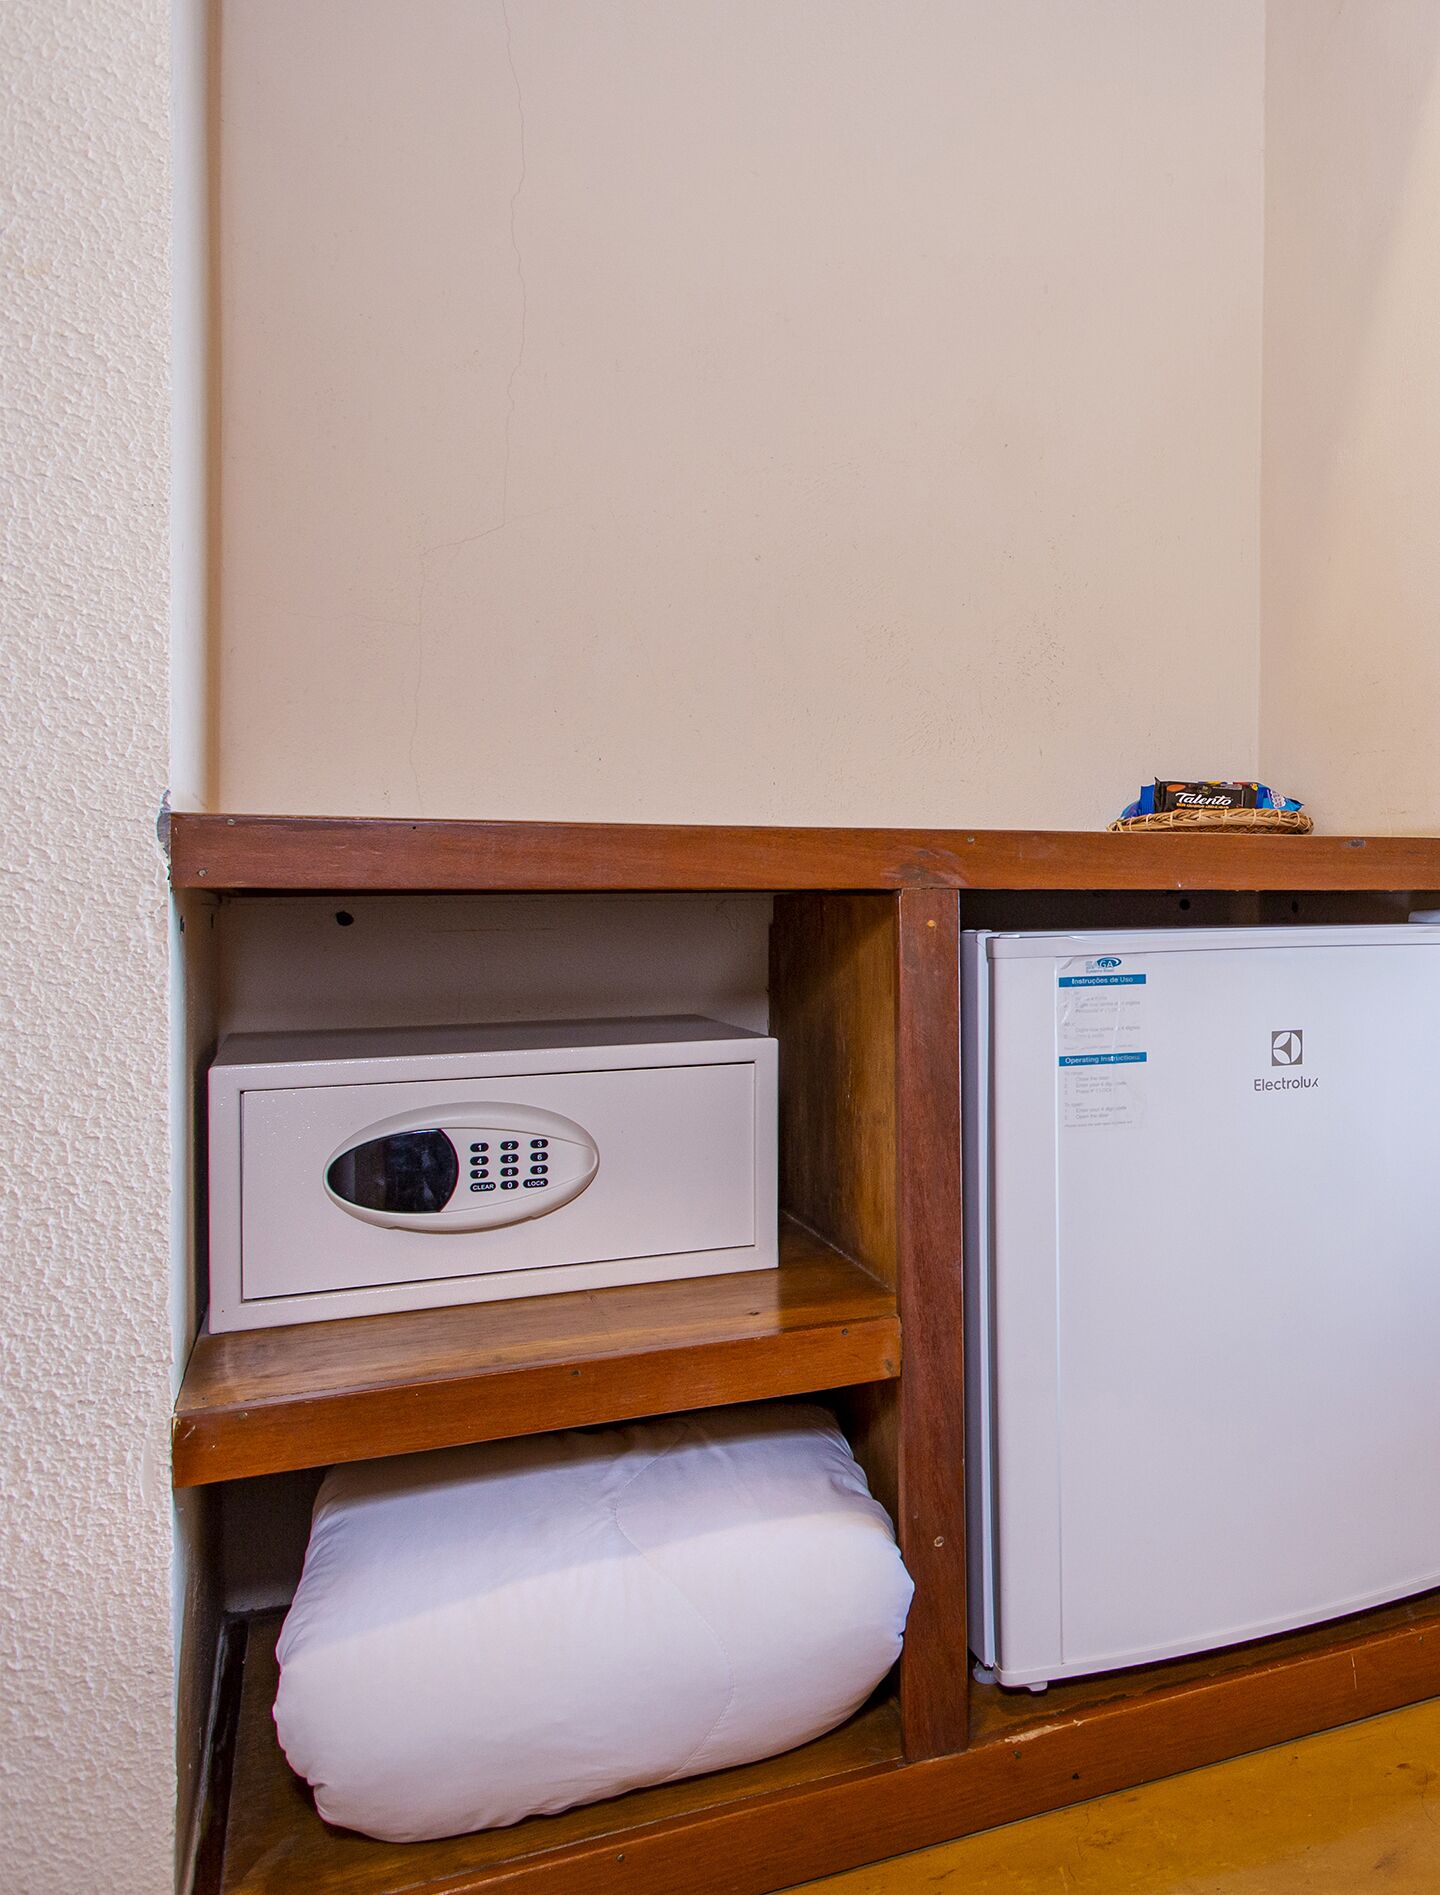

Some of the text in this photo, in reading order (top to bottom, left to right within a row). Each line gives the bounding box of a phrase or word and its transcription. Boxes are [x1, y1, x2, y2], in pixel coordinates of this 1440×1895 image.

[1175, 792, 1232, 805] Talento
[1071, 976, 1108, 985] Instruções
[1119, 975, 1134, 983] Uso
[1065, 1056, 1100, 1066] Operating
[1254, 1076, 1319, 1091] Electrolux
